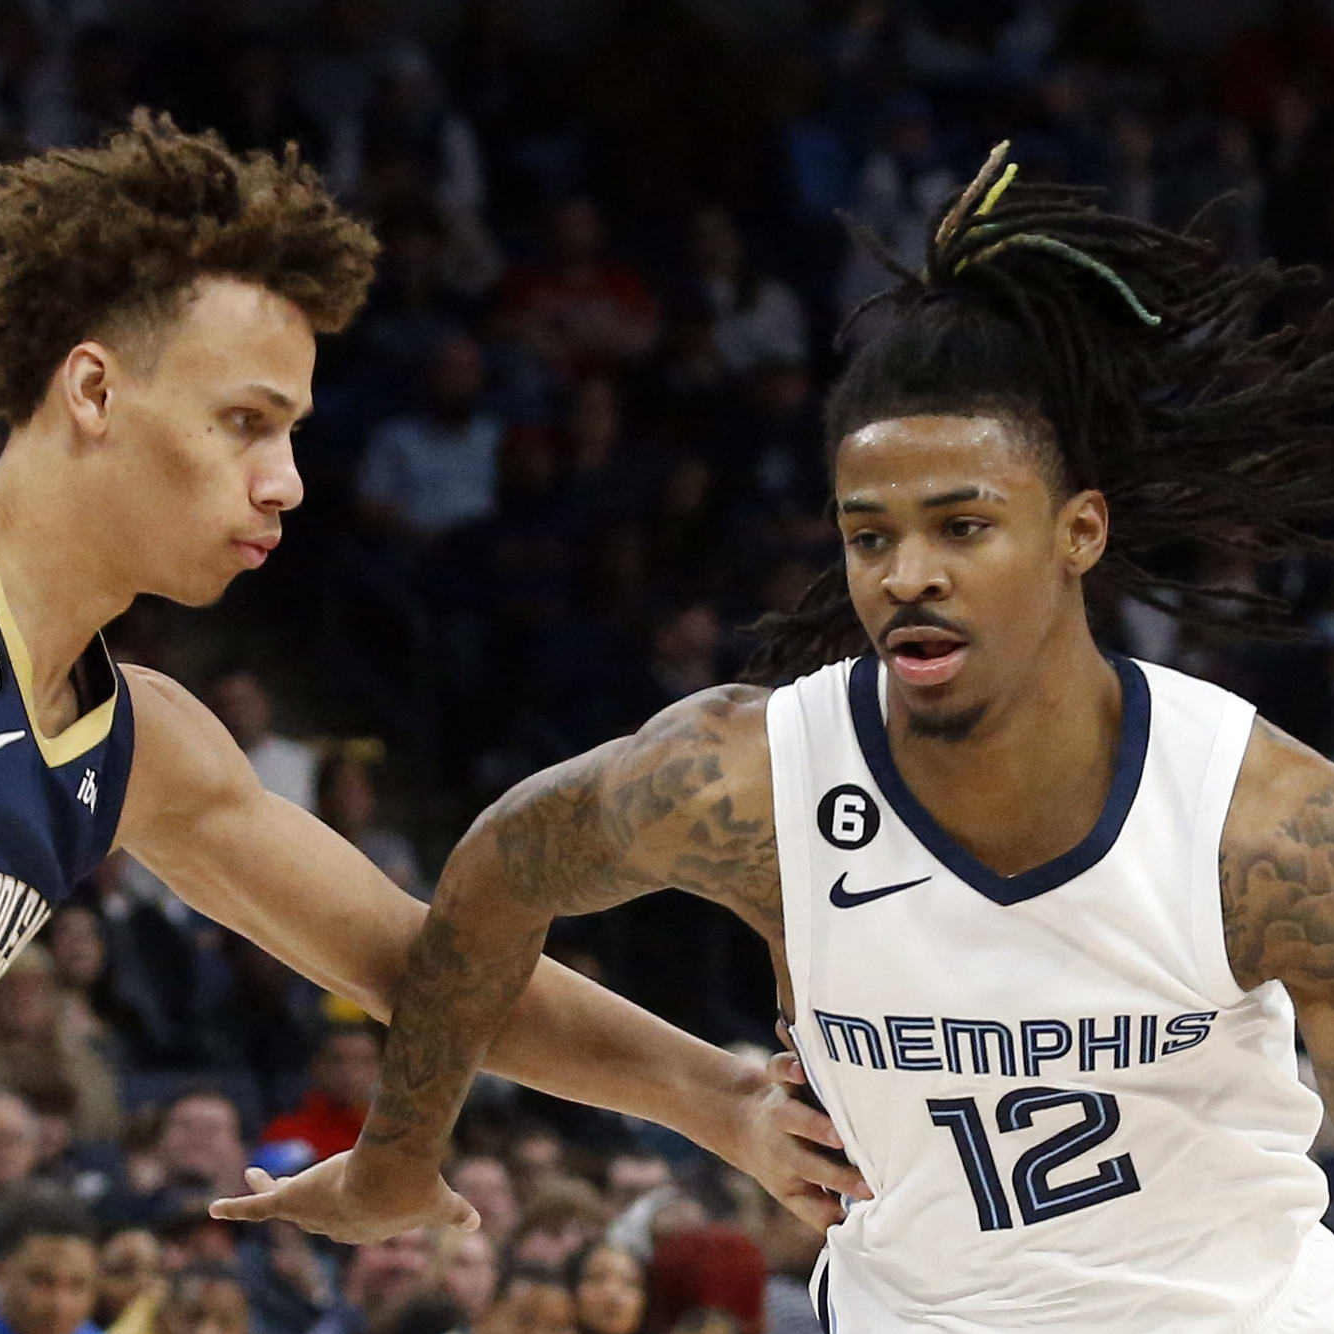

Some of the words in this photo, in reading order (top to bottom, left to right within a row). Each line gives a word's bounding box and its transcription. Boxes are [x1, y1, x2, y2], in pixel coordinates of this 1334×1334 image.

[830, 792, 867, 844] 6
[813, 1008, 1219, 1077] MEMPHIS
[925, 1086, 1142, 1232] 12
